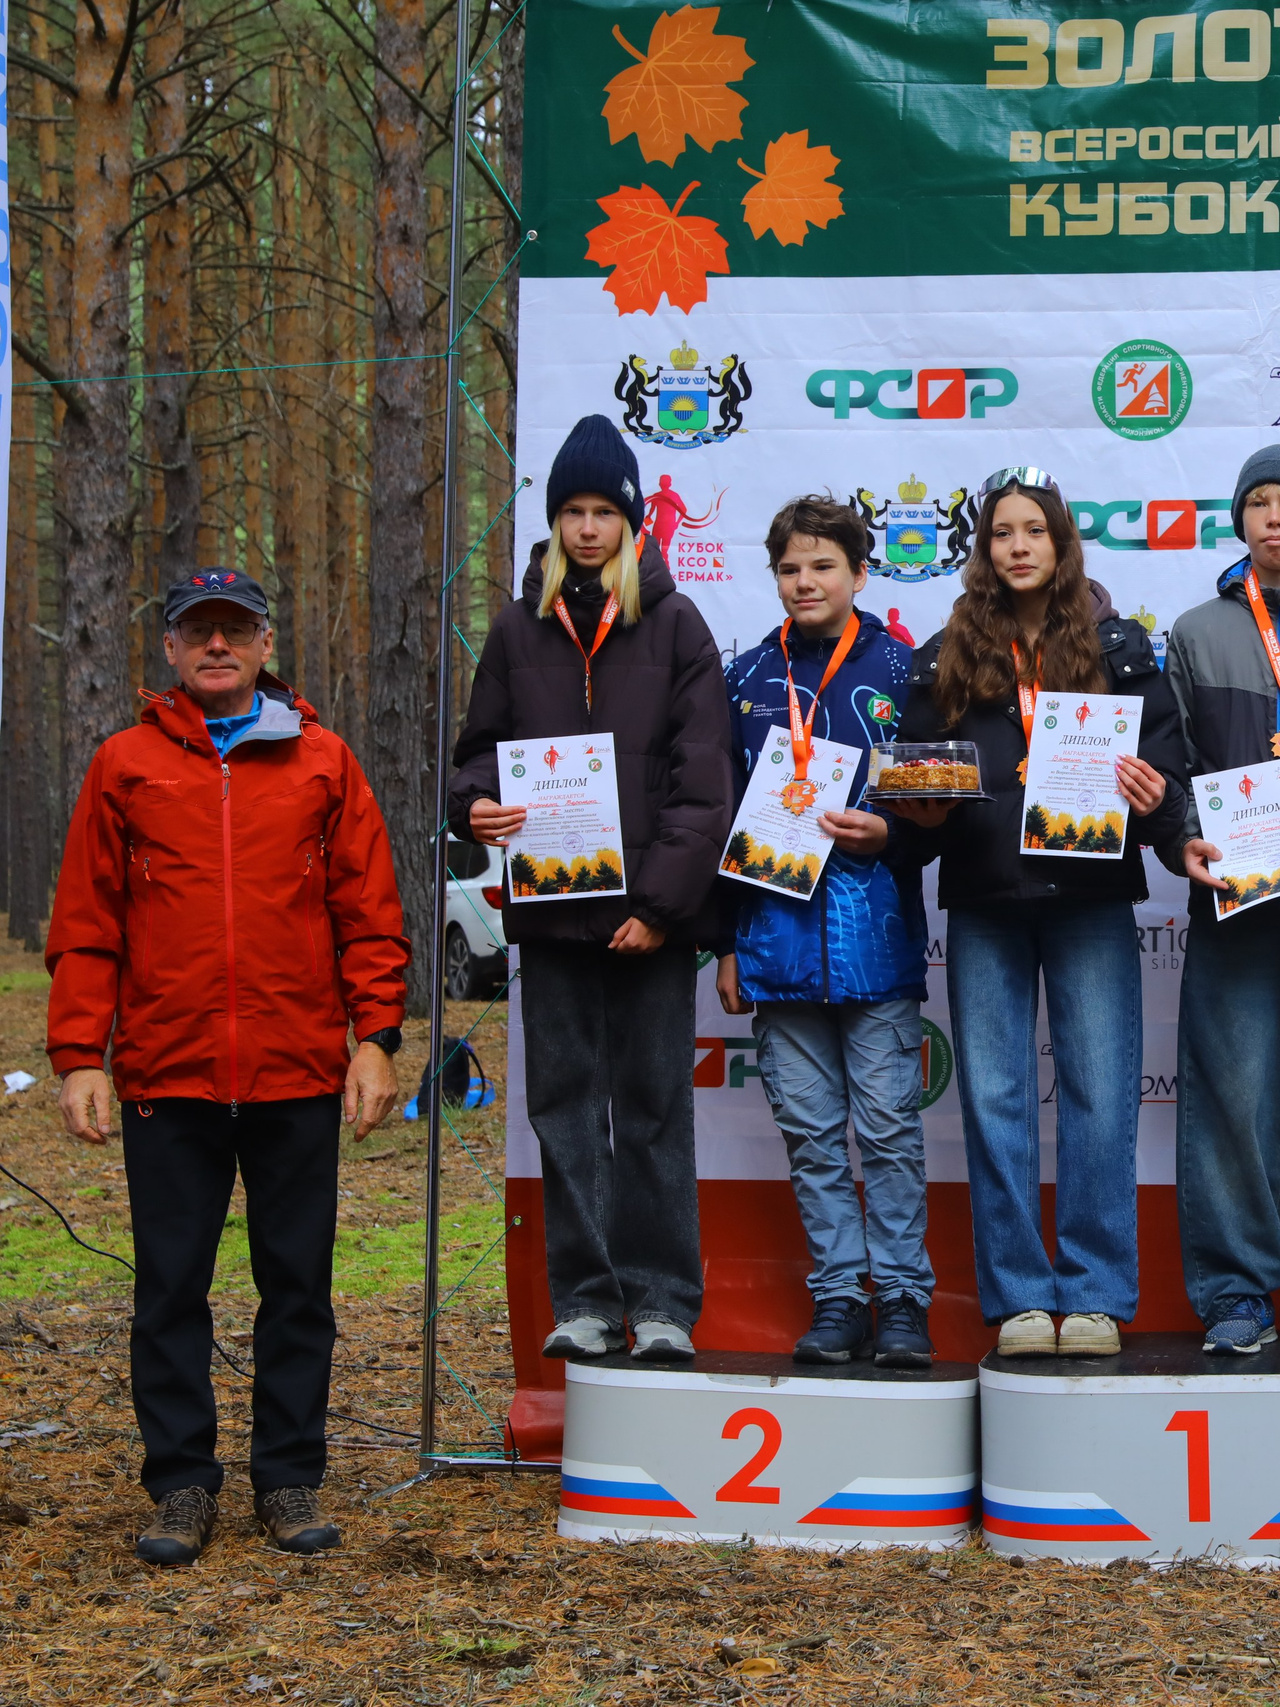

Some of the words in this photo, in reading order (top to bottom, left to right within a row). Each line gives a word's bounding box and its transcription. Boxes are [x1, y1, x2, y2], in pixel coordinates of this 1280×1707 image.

[1009, 179, 1280, 237] КУБОК
[1096, 353, 1120, 392] ФЕДЕРАЦИЯ
[1122, 344, 1173, 359] СПОРТИВНОГО
[678, 542, 724, 553] КУБОК
[678, 557, 708, 567] КСО
[671, 571, 733, 582] «ЕРМАК»
[1268, 628, 1280, 654] ОСЕНЬ
[795, 707, 804, 741] ЗОЛОТАЯ
[1059, 734, 1112, 746] ДИПЛОМ
[532, 778, 587, 792] ДИПЛОМ
[802, 784, 811, 795] 2
[928, 1037, 948, 1099] ОРИЕНТИРОВАНИЯ
[716, 1408, 783, 1504] 2
[1164, 1410, 1211, 1522] 1
